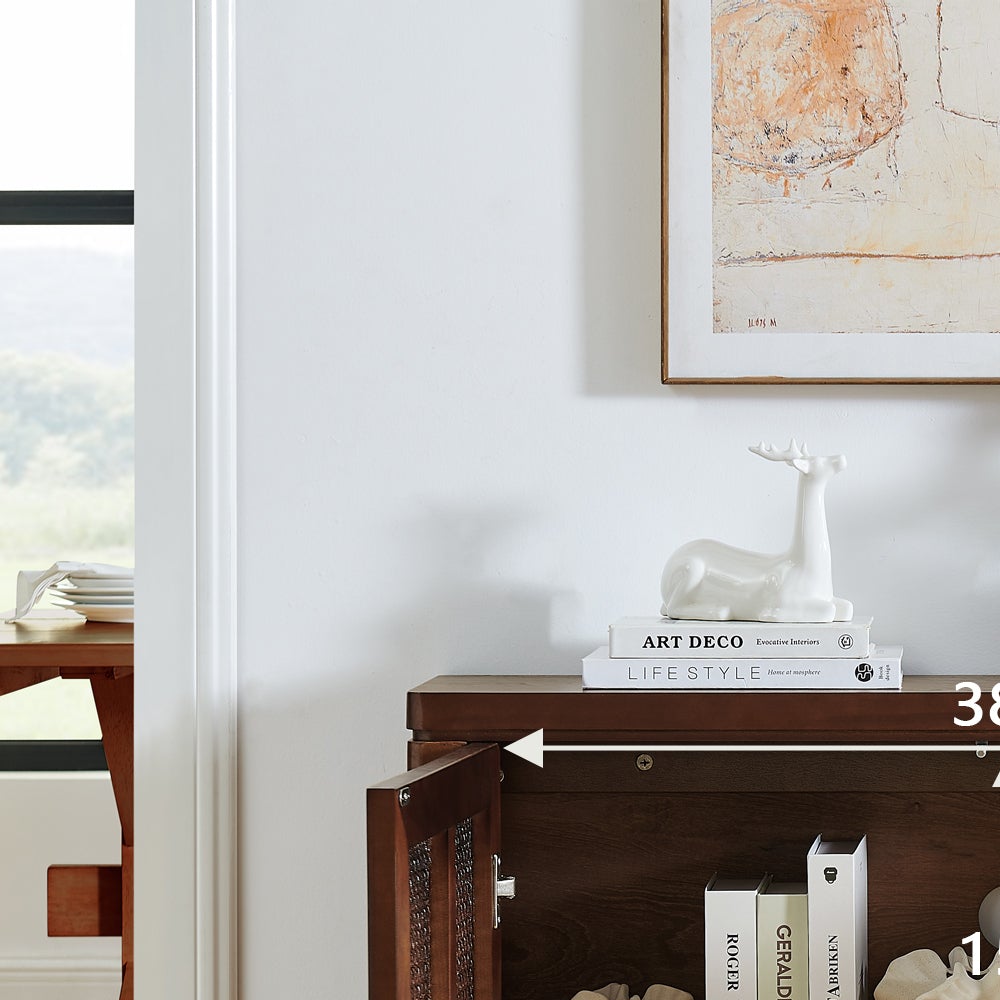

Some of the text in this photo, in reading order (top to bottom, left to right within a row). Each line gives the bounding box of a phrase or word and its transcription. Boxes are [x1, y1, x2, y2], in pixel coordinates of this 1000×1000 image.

[642, 635, 744, 649] ART DECO
[756, 638, 820, 646] Evocative Interiors
[767, 668, 785, 676] Home
[726, 933, 740, 991] ROGER
